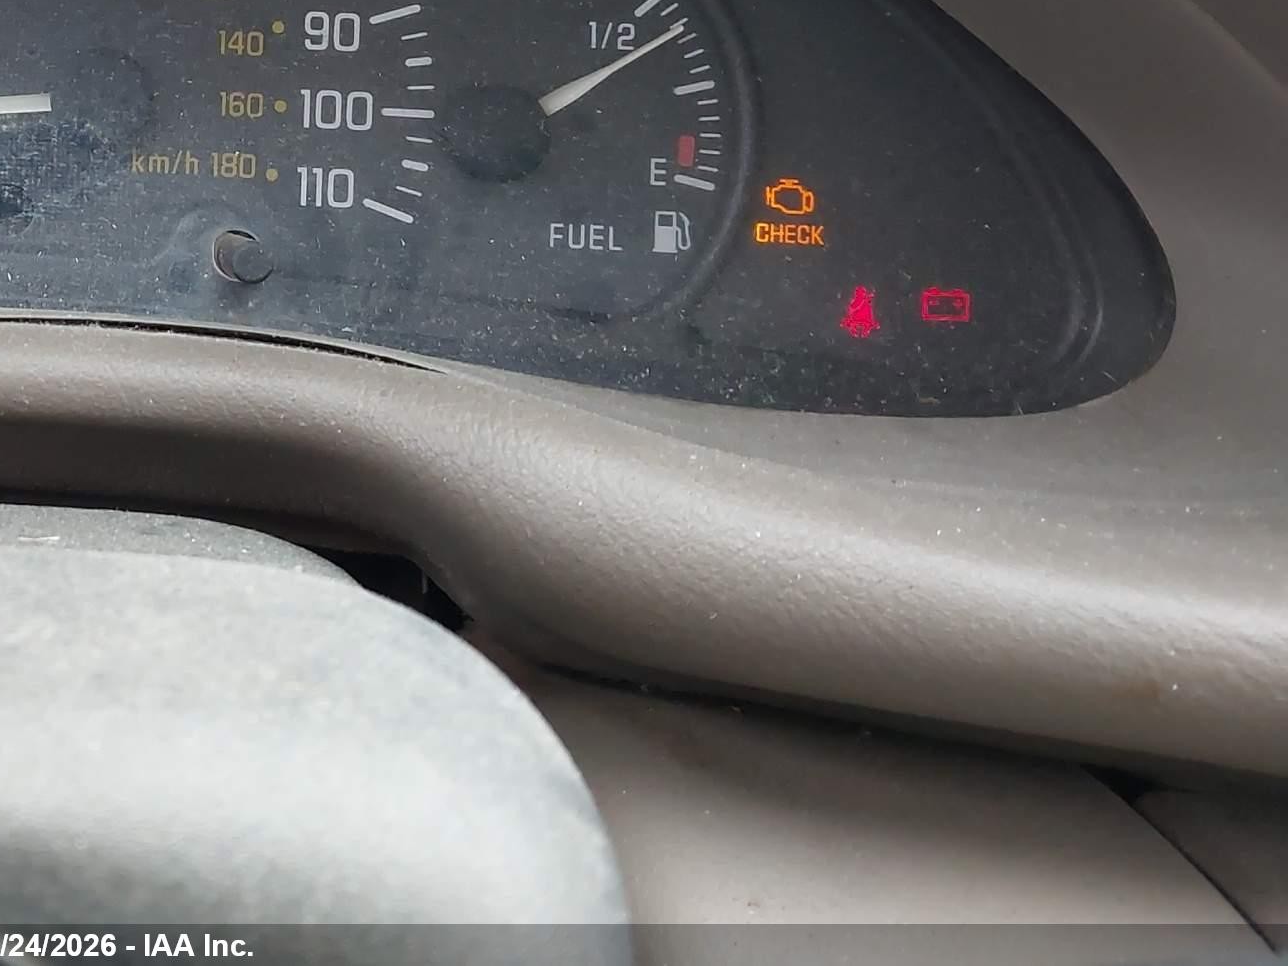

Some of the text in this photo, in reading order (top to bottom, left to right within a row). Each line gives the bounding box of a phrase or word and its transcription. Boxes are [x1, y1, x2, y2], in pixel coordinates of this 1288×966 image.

[219, 31, 264, 55] 140
[304, 11, 360, 51] 90
[588, 22, 635, 51] 1/2
[220, 92, 263, 116] 160
[301, 89, 373, 130] 100
[130, 152, 255, 178] km/h 180
[650, 158, 667, 185] E
[297, 167, 354, 207] 110
[549, 223, 622, 251] FUEL
[756, 224, 823, 245] CHECK
